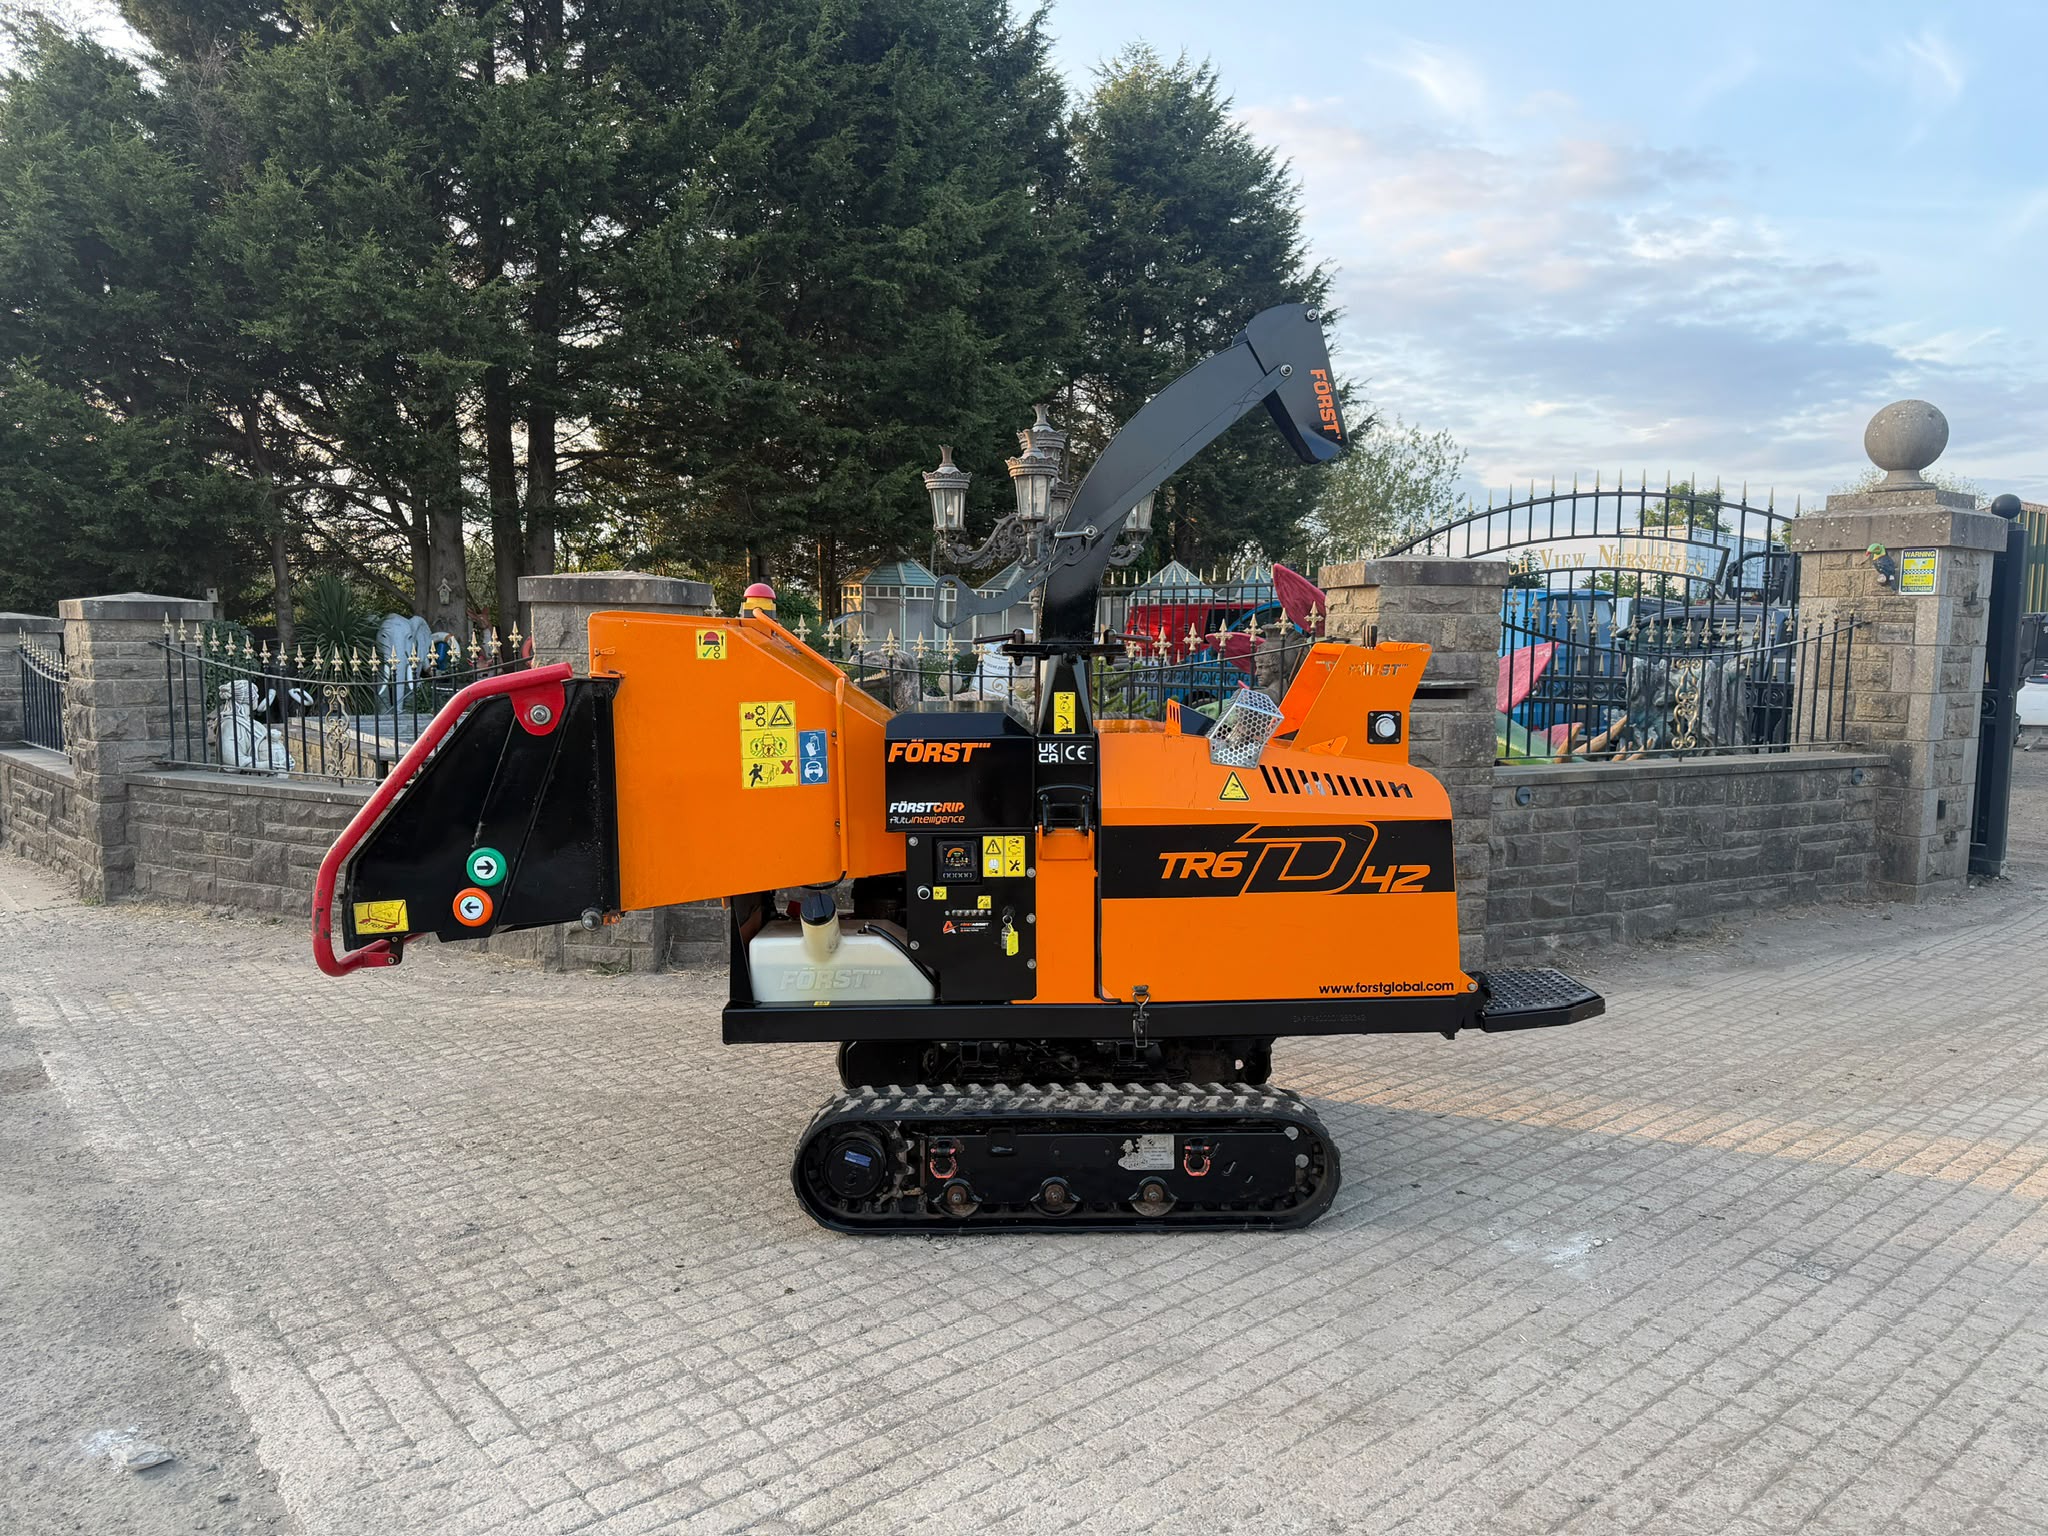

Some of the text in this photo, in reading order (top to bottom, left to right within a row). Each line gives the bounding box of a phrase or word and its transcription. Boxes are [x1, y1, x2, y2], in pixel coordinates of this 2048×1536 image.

[1310, 369, 1342, 440] FÖRST
[1540, 548, 1586, 570] VIEW
[887, 739, 991, 763] FÖRST
[1038, 743, 1058, 753] UK
[1065, 745, 1087, 760] CE
[1038, 753, 1058, 763] CA
[1158, 851, 1249, 879] TR6
[1360, 865, 1431, 893] 42
[1319, 981, 1454, 996] www.forstglobal.com
